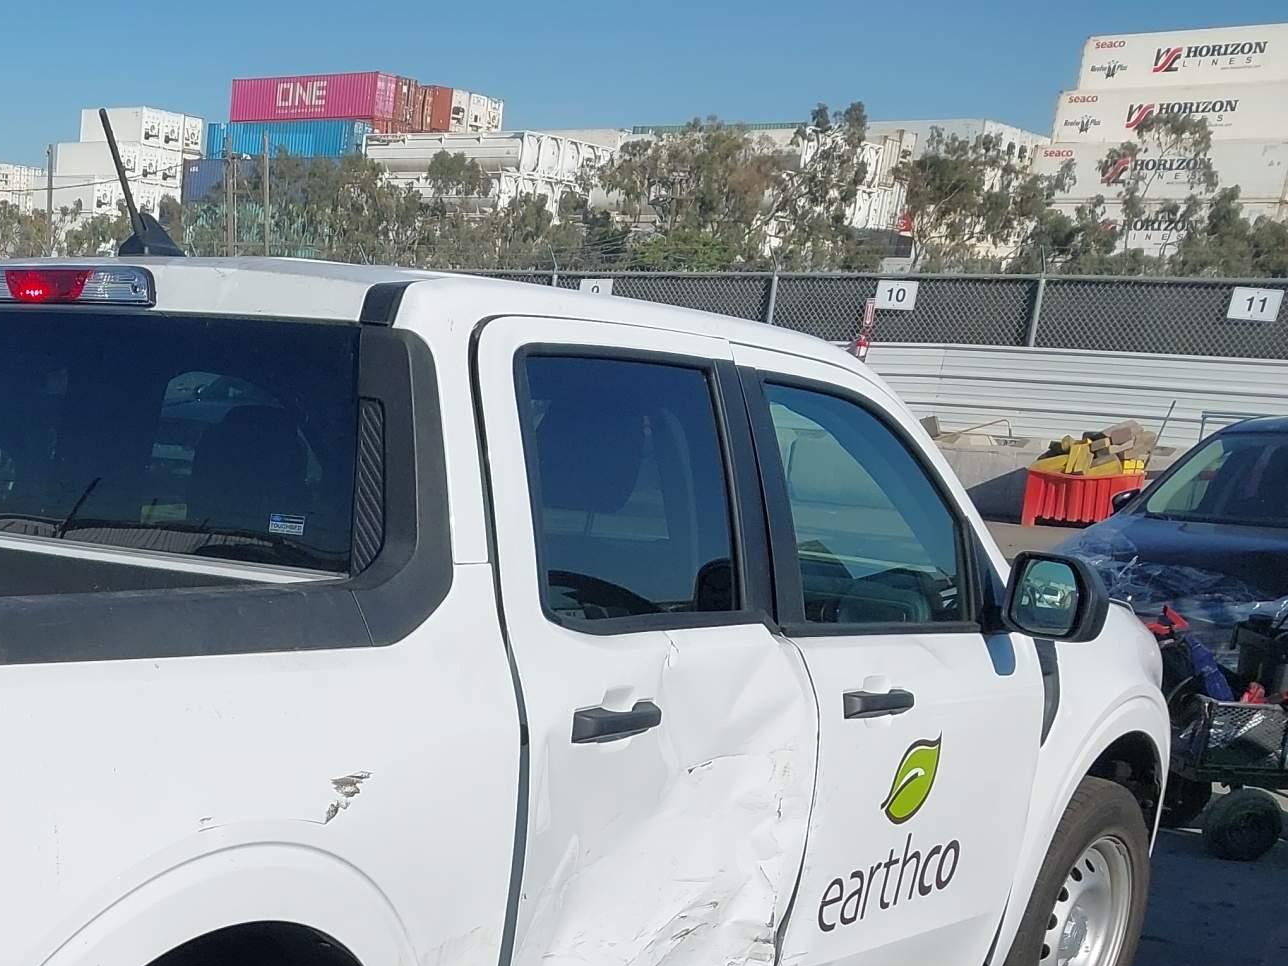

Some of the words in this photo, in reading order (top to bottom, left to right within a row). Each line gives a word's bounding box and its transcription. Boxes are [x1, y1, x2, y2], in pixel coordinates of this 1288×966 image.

[1095, 40, 1126, 49] seaco
[1184, 41, 1268, 58] HORIZON
[1182, 56, 1253, 68] LINES
[276, 81, 327, 107] ONE
[1068, 95, 1099, 104] seaco
[1158, 99, 1240, 114] HORIZON
[1043, 148, 1074, 158] seaco
[887, 287, 907, 303] 10
[1245, 296, 1268, 313] 11
[817, 832, 960, 932] earthco
